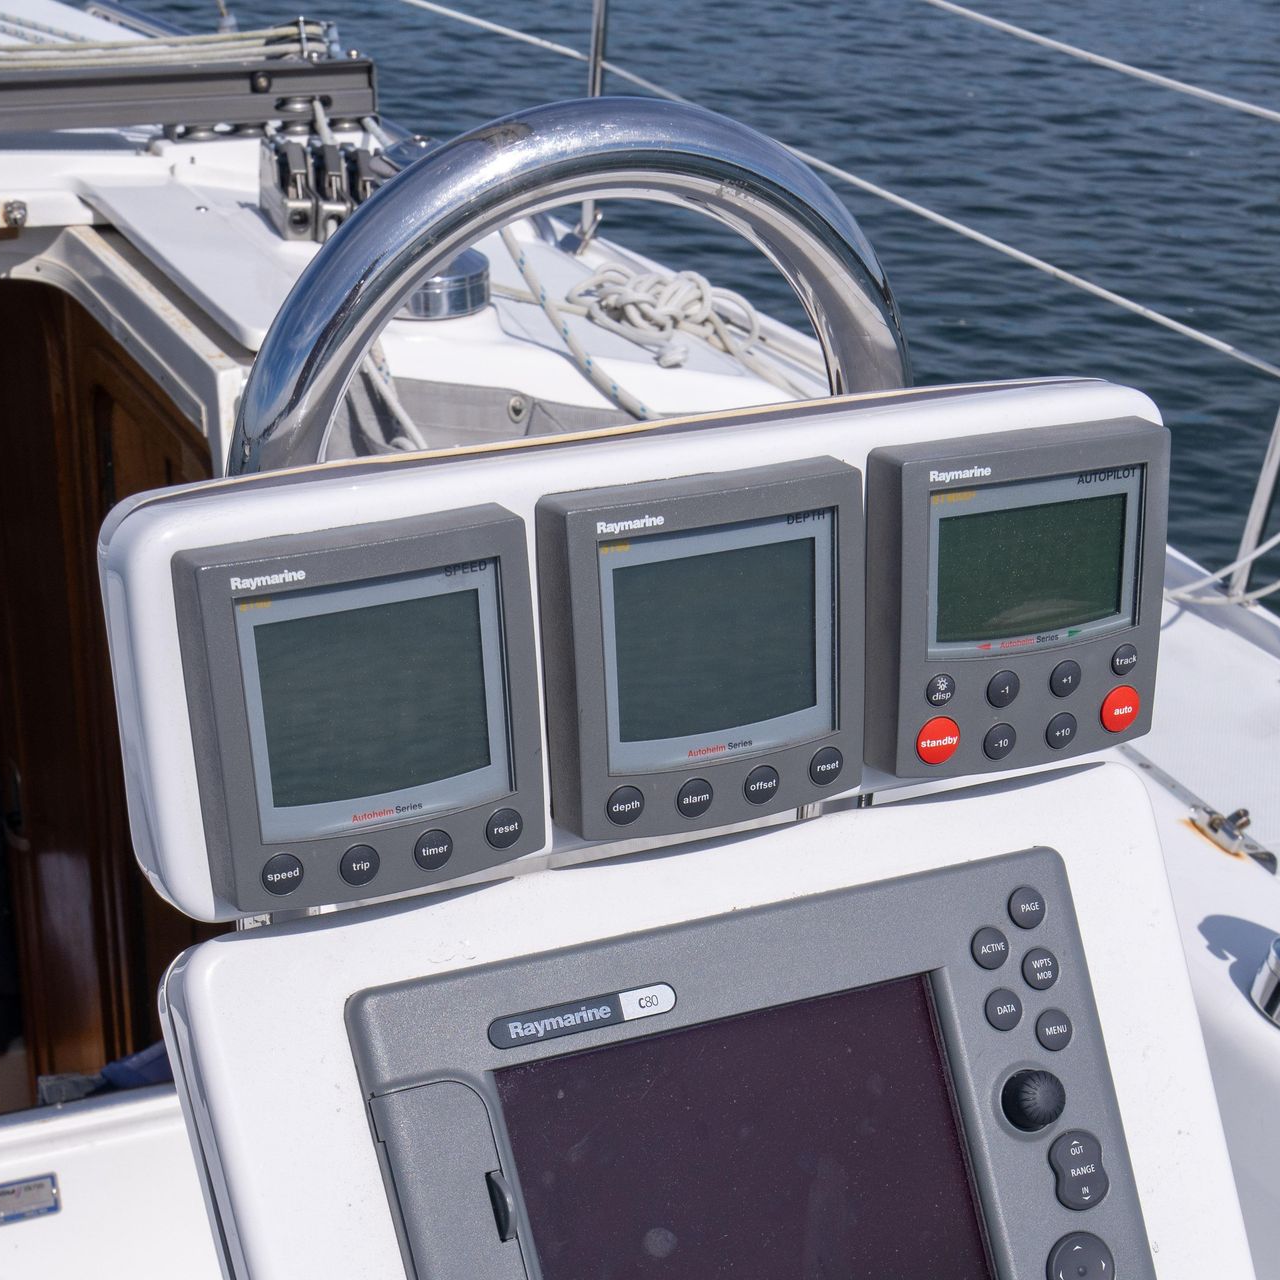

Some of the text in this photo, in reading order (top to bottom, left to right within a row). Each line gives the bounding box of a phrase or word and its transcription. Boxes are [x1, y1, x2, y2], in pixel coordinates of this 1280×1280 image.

[929, 465, 992, 483] Raymarine
[1077, 467, 1137, 485] AUTOPILOT
[786, 510, 826, 526] DEPTH
[596, 514, 665, 535] Raymarine
[444, 560, 487, 577] SPEED
[230, 569, 306, 591] Raymarine
[1036, 633, 1059, 644] Series
[1115, 654, 1137, 667] track
[1061, 675, 1072, 685] +1
[932, 690, 951, 702] disp
[1113, 705, 1133, 715] auto
[1055, 727, 1071, 737] +10
[920, 735, 958, 748] standby
[994, 738, 1009, 748] -10
[687, 738, 753, 759] Autohelm Series
[816, 760, 840, 772] reset
[749, 779, 777, 791] offset
[682, 793, 709, 804] alarm
[612, 799, 641, 813] depth
[351, 801, 423, 824] Autohelm Series
[493, 821, 519, 834] reset
[421, 843, 448, 856] timer
[352, 859, 371, 873] trip
[267, 867, 300, 884] speed
[1020, 902, 1040, 913] PAGE
[980, 942, 1006, 954] ACTIVE
[1032, 958, 1052, 969] WPTS
[1036, 971, 1053, 981] MOB
[997, 1004, 1016, 1015] DATA
[508, 1003, 611, 1039] Raymarine
[1045, 1025, 1067, 1036] MENU
[1070, 1145, 1084, 1156] OUT
[1070, 1163, 1095, 1177] RANGE
[1082, 1186, 1090, 1194] IN
